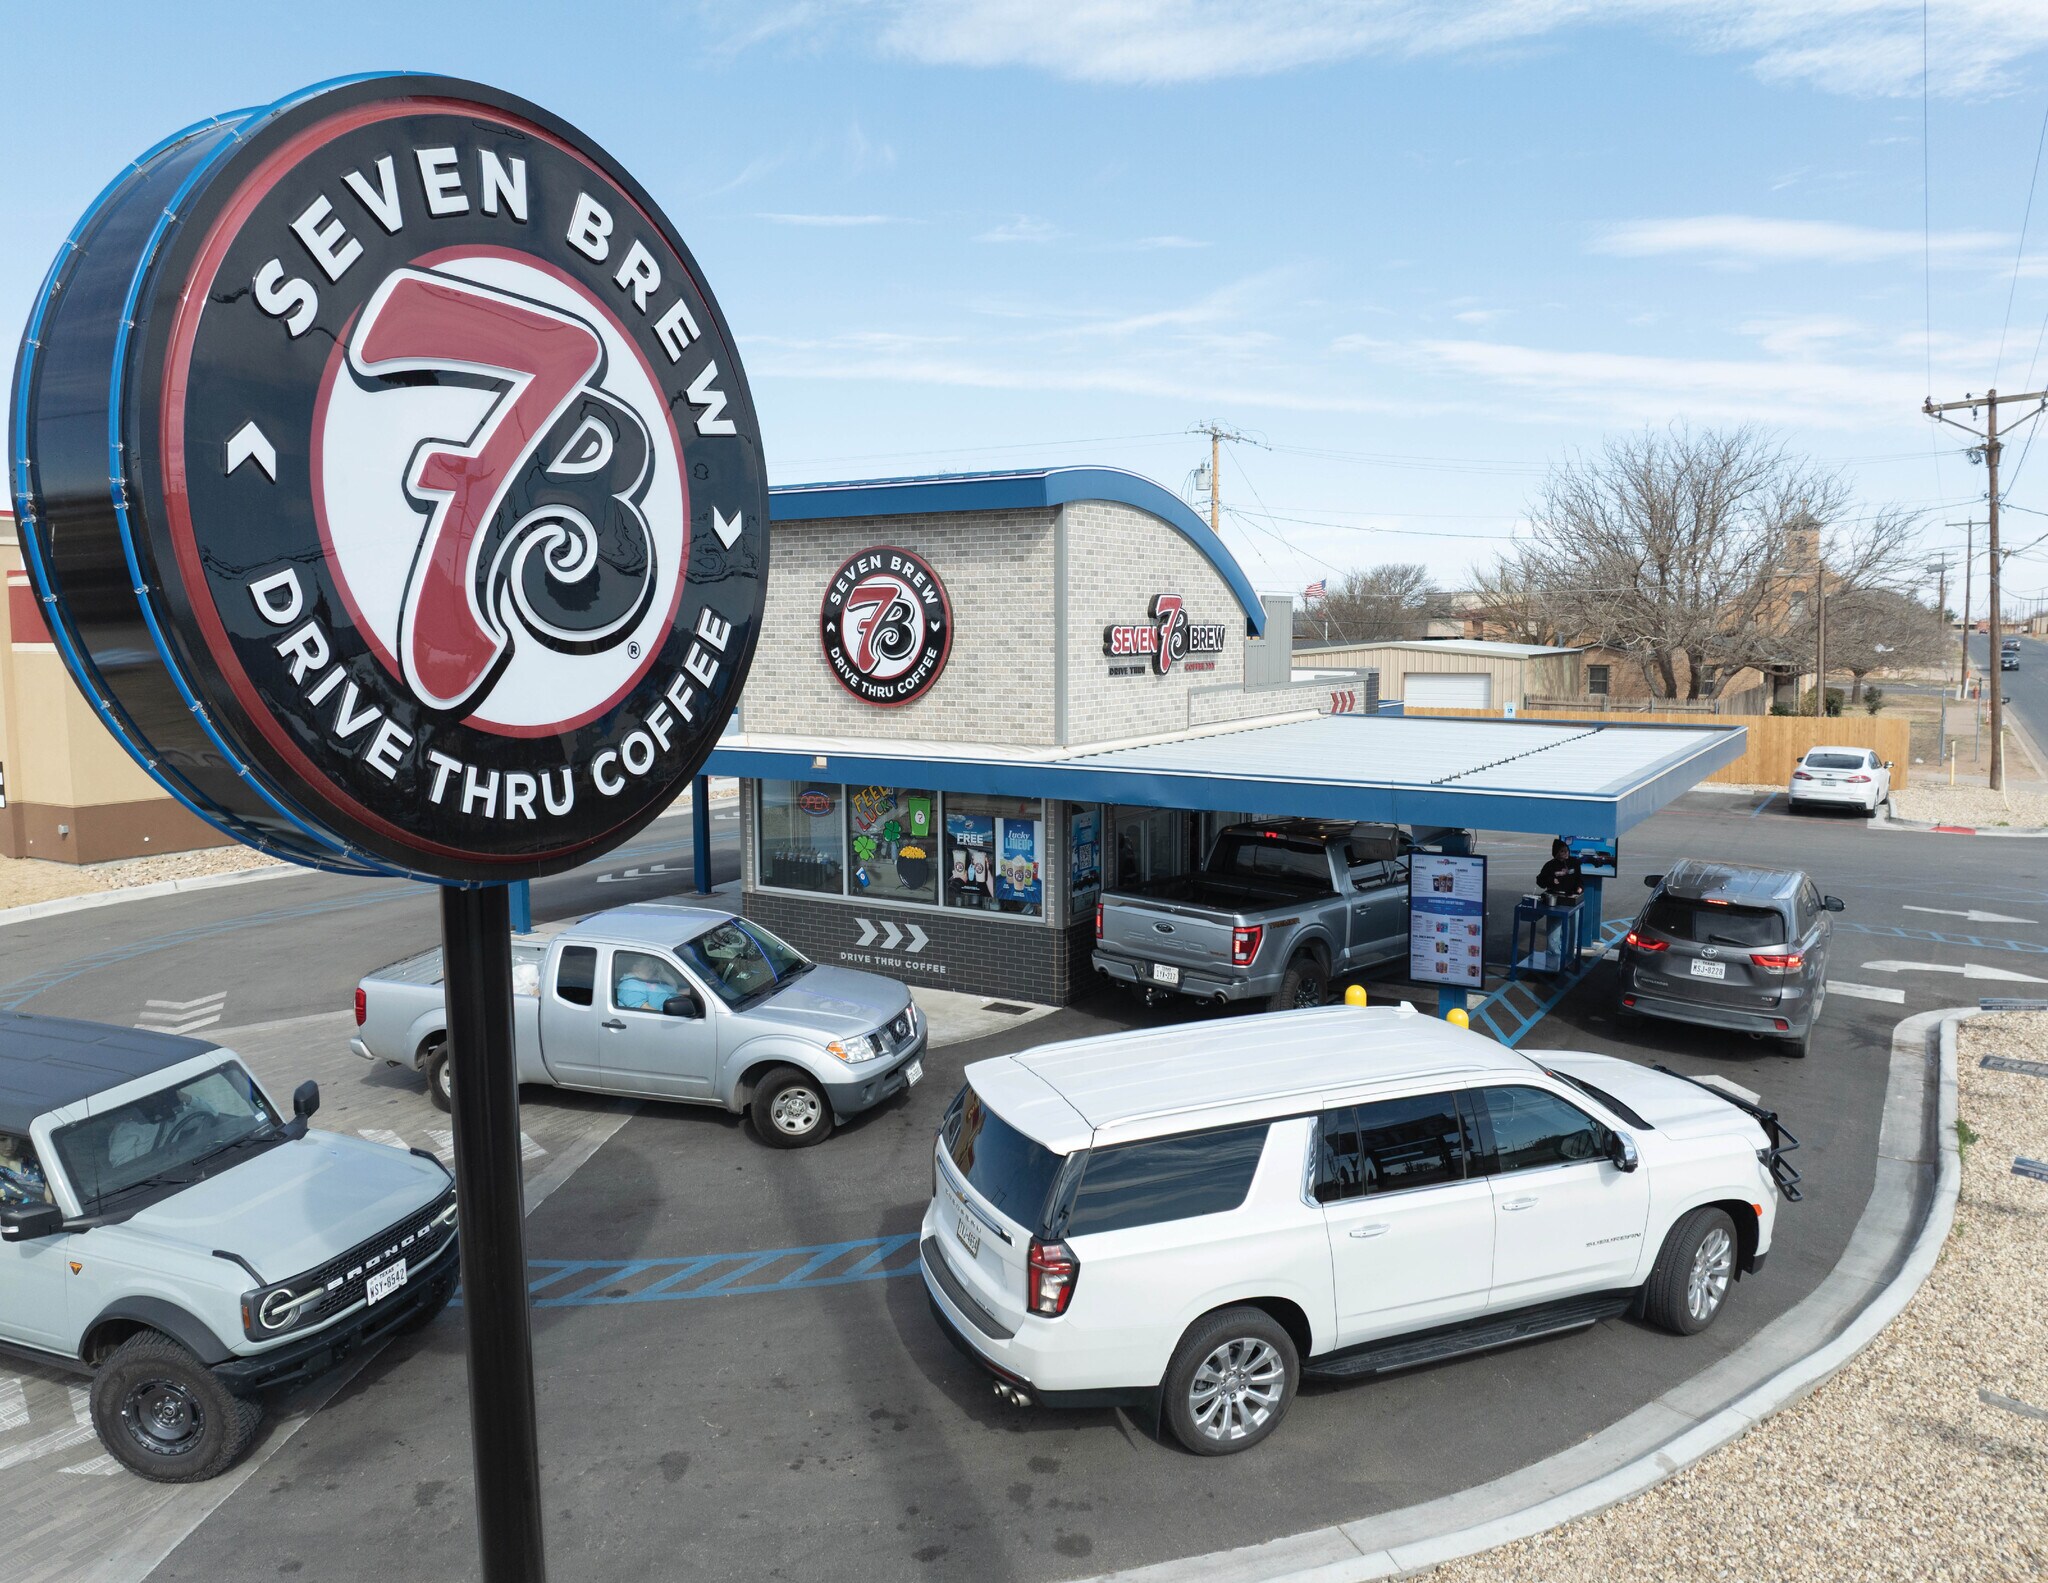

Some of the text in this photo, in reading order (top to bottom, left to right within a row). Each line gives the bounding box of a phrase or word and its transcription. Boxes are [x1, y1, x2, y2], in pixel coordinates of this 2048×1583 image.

[252, 146, 737, 437] SEVEN BREW
[830, 554, 939, 606] SEVEN BREW
[1111, 626, 1158, 655] SEVEN
[1189, 625, 1226, 651] BREW
[830, 646, 938, 698] DRIVE THRU COFFEE
[1108, 667, 1129, 676] DRIVE
[249, 567, 733, 820] DRIVE THRU COFFEE
[800, 795, 831, 810] OPEN
[853, 785, 892, 813] FEEL
[855, 792, 898, 832] LUCKY
[956, 832, 984, 844] FREE
[1005, 838, 1033, 851] LINEUP
[1008, 830, 1031, 841] Lucky
[840, 951, 947, 974] DRIVE THRU COFFEE
